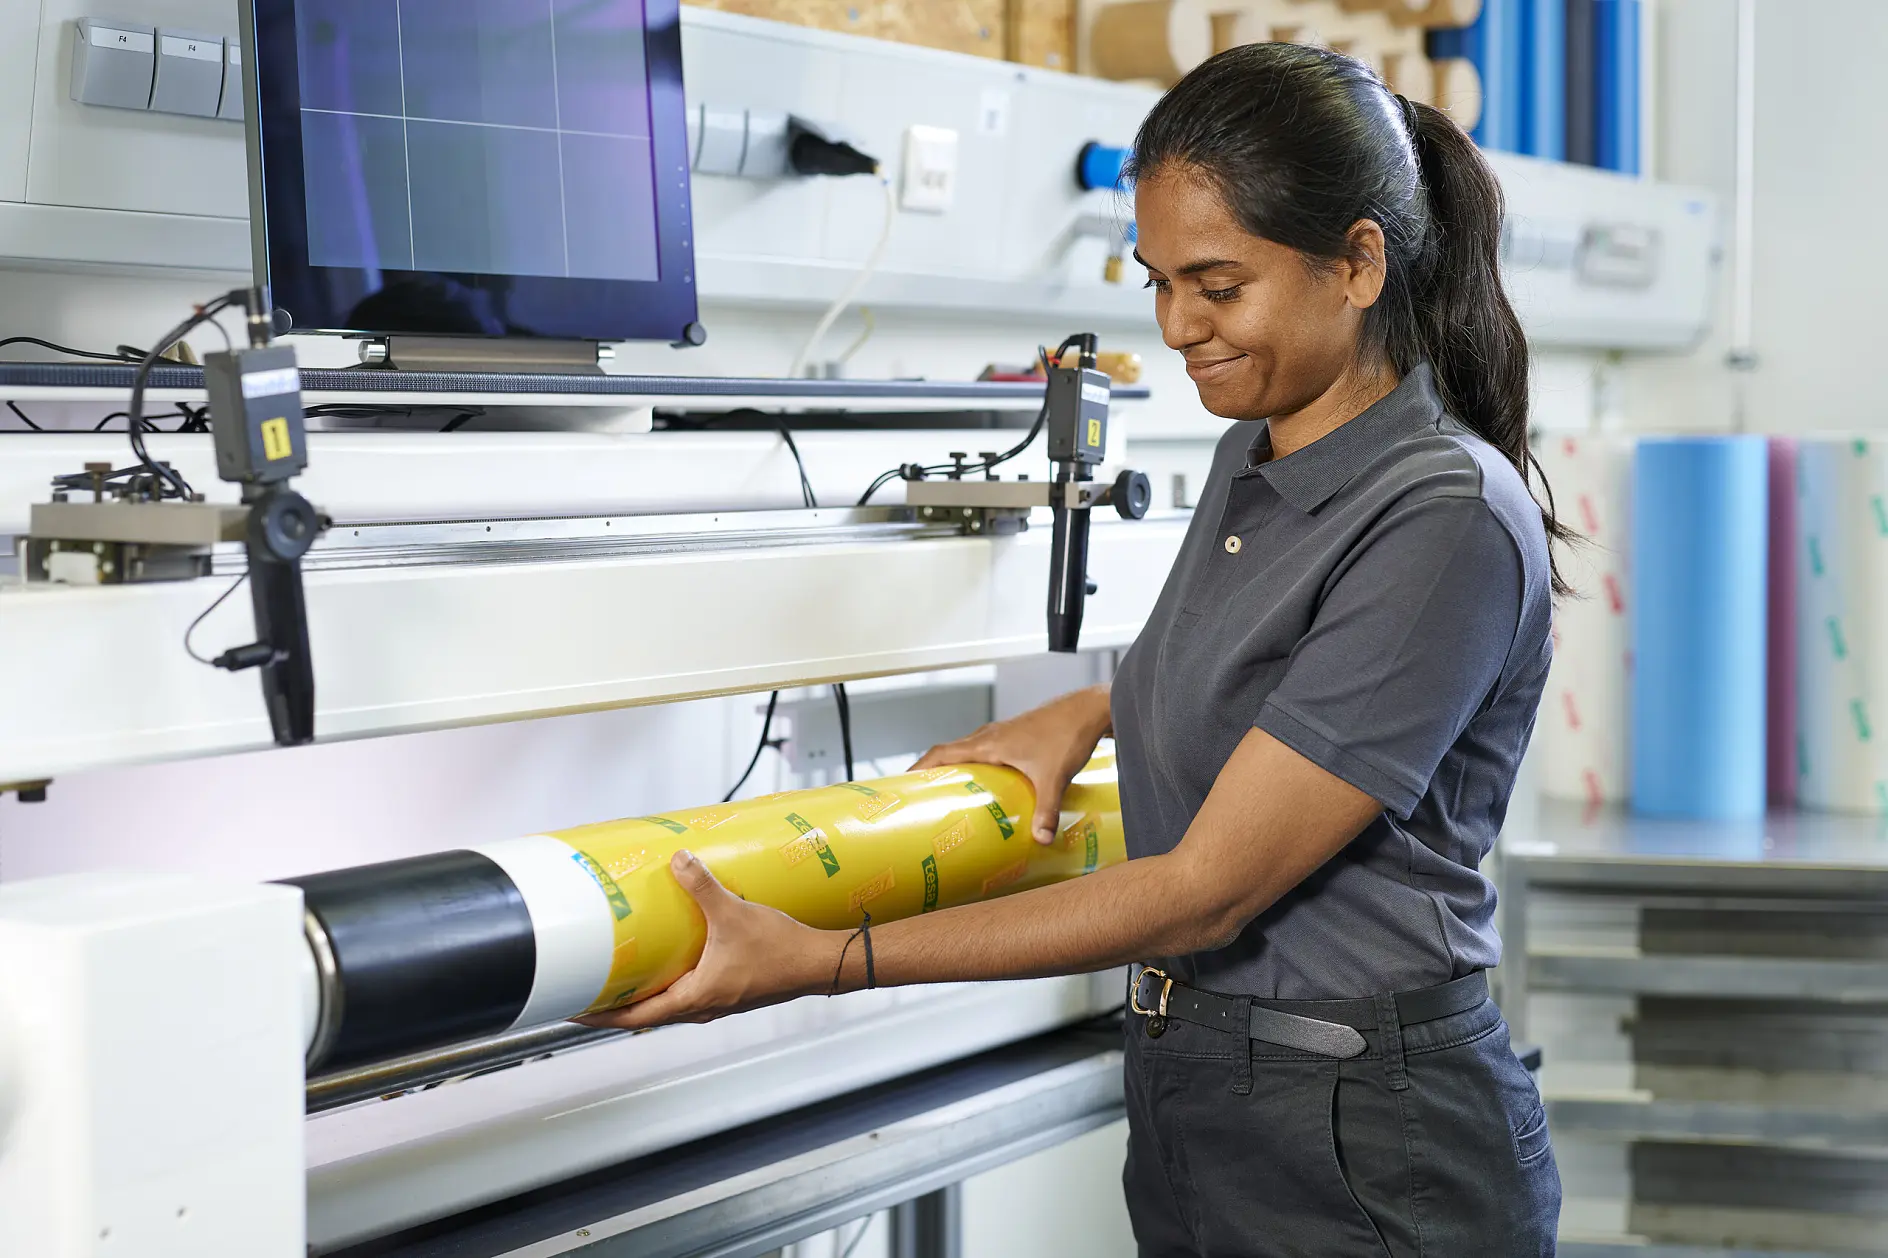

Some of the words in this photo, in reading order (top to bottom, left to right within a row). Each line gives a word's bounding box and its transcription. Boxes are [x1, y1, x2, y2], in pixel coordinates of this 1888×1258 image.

[118, 35, 127, 43] F4
[188, 44, 196, 52] F4
[270, 425, 280, 452] 1
[925, 860, 936, 901] tesa
